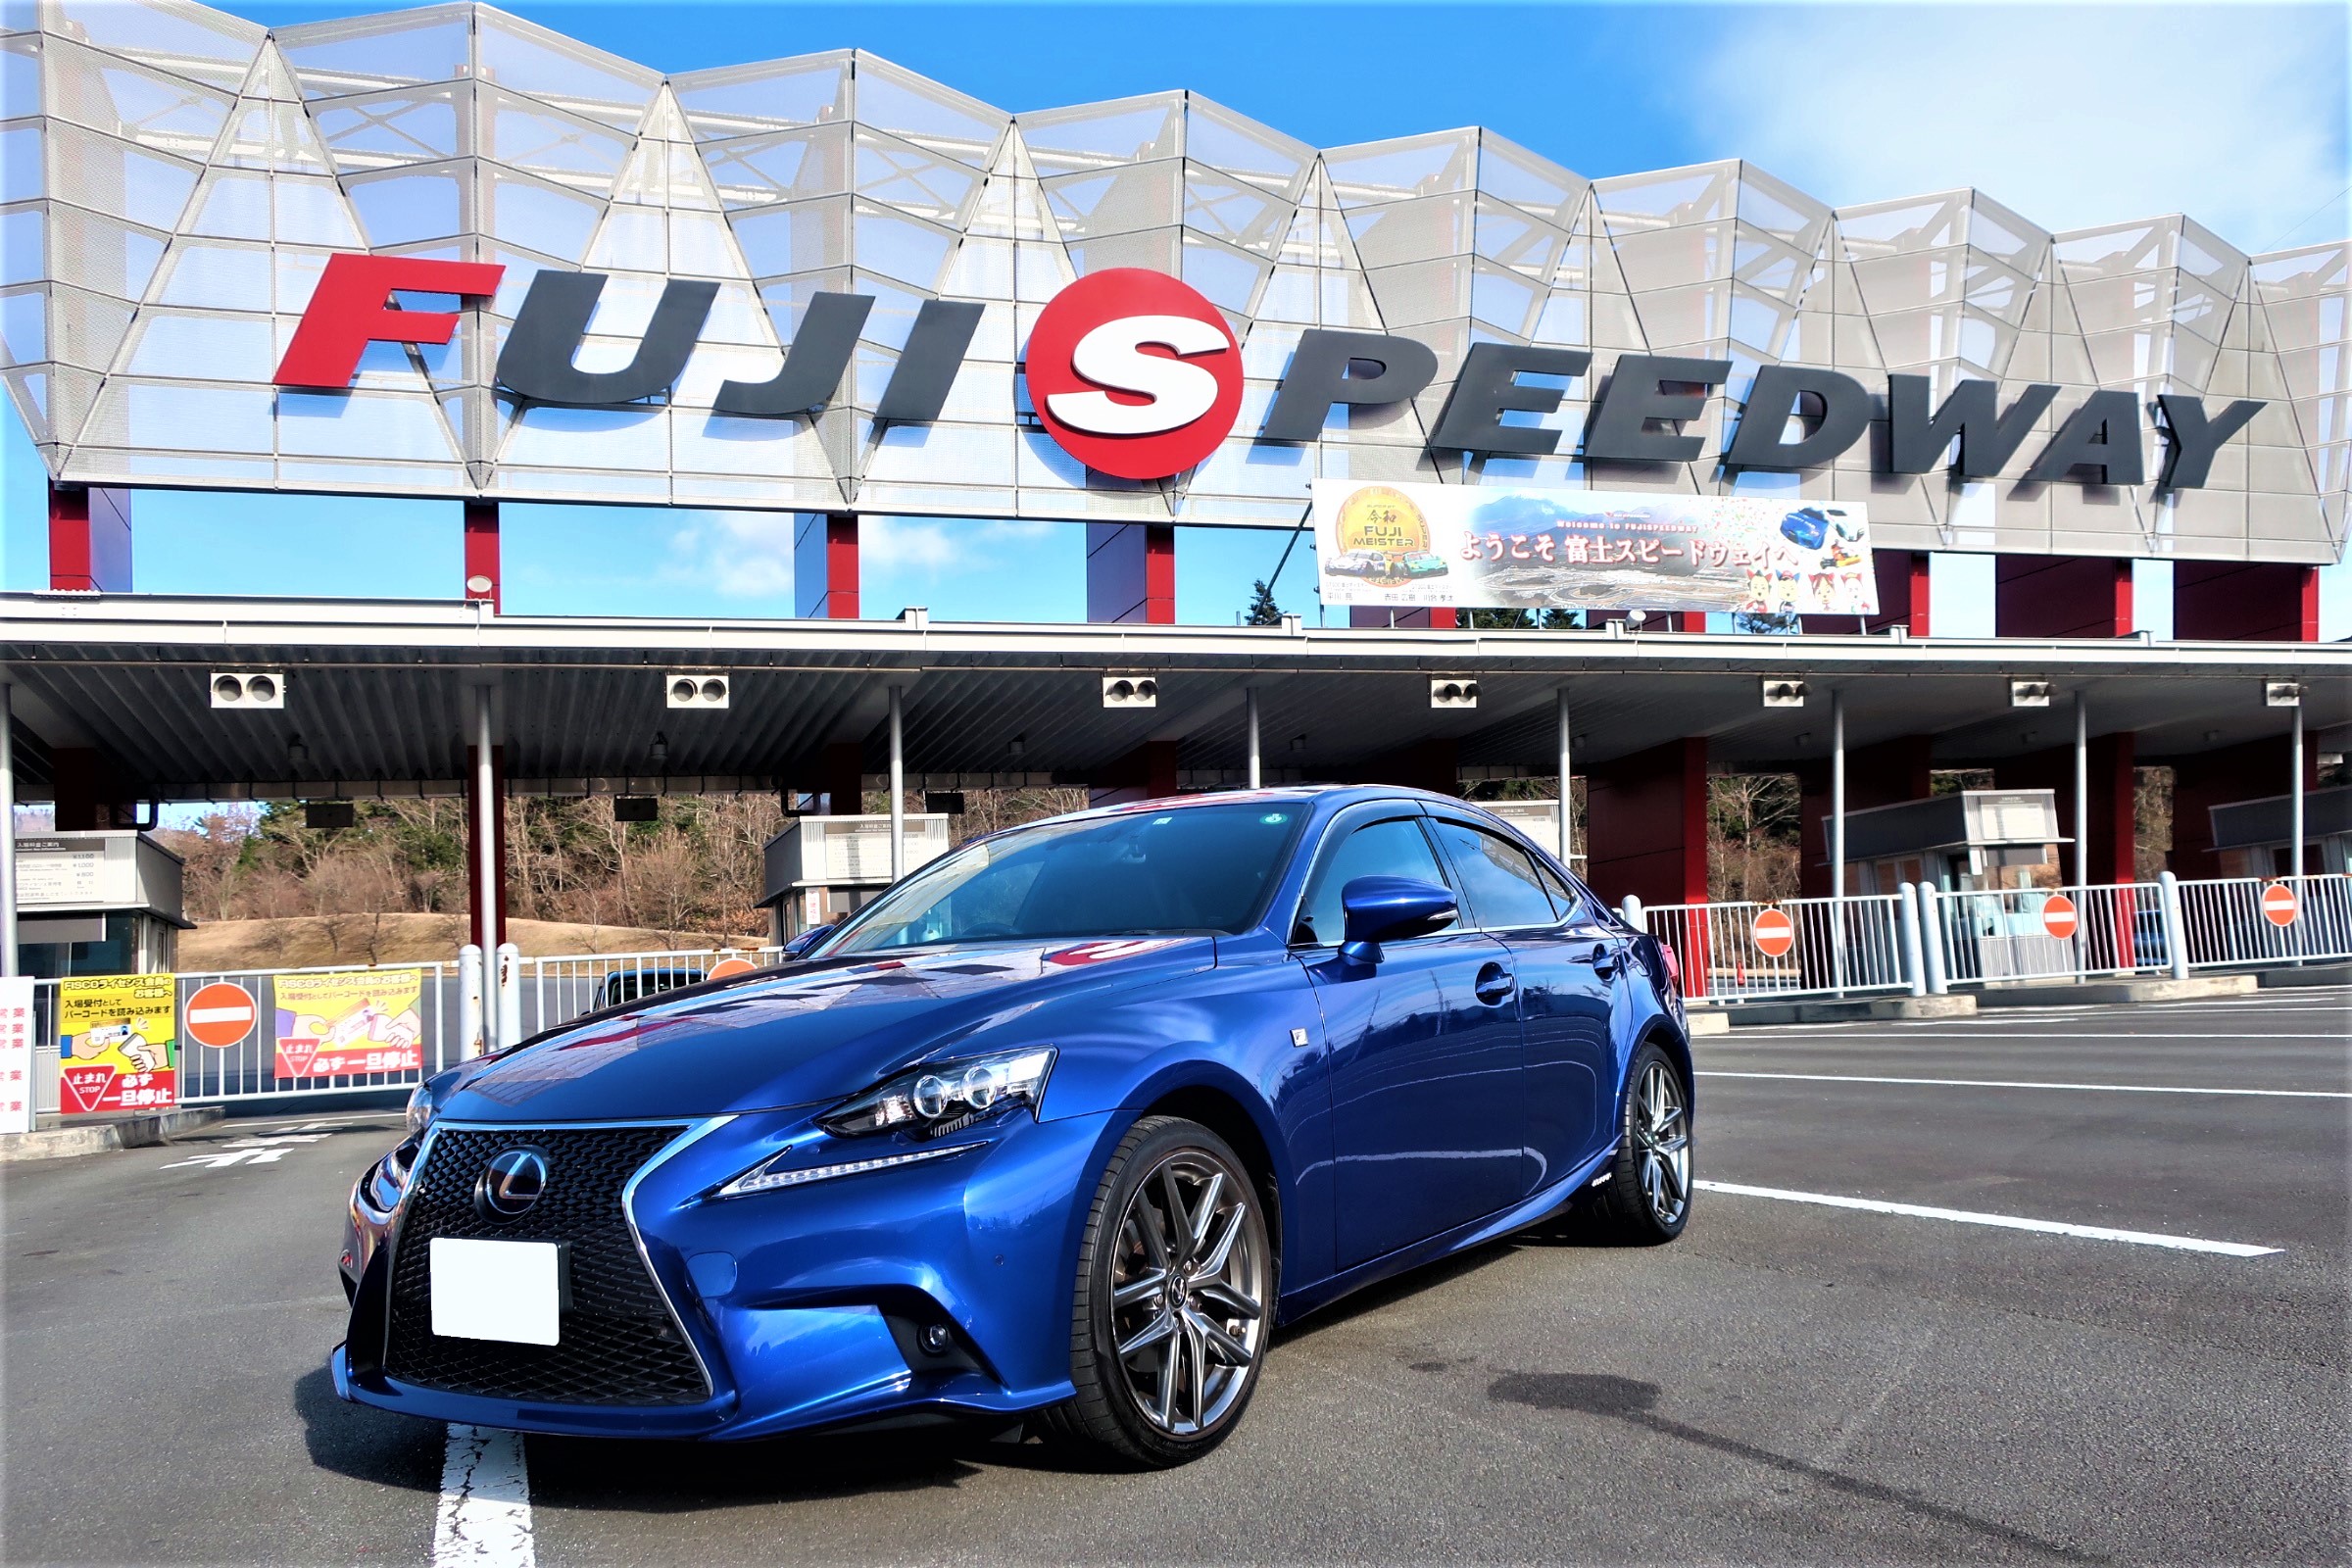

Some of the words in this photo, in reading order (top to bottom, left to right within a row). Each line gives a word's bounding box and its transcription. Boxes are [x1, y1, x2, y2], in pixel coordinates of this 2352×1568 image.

[273, 252, 985, 422] FUJI
[1367, 509, 1397, 524] 令和
[1363, 525, 1402, 537] FUJI
[1555, 519, 1605, 530] Welcome
[1609, 521, 1622, 530] to
[1624, 522, 1699, 534] FUJISPEEDWAY
[1352, 537, 1415, 547] MEISTER
[1459, 530, 1557, 563] ようこそ
[1563, 533, 1799, 570] 富士スピードウェイへ
[64, 976, 172, 991] FISCOライセンス会員の
[133, 987, 172, 999] お客様へ
[65, 999, 122, 1008] 入場受付として
[64, 1005, 172, 1019] バーコードを読み込みます
[285, 1044, 314, 1054] 止まれ
[73, 1073, 107, 1085] 止まれ
[122, 1073, 154, 1089] 必ず
[79, 1086, 101, 1095] STOP
[102, 1088, 173, 1106] 一旦停止
